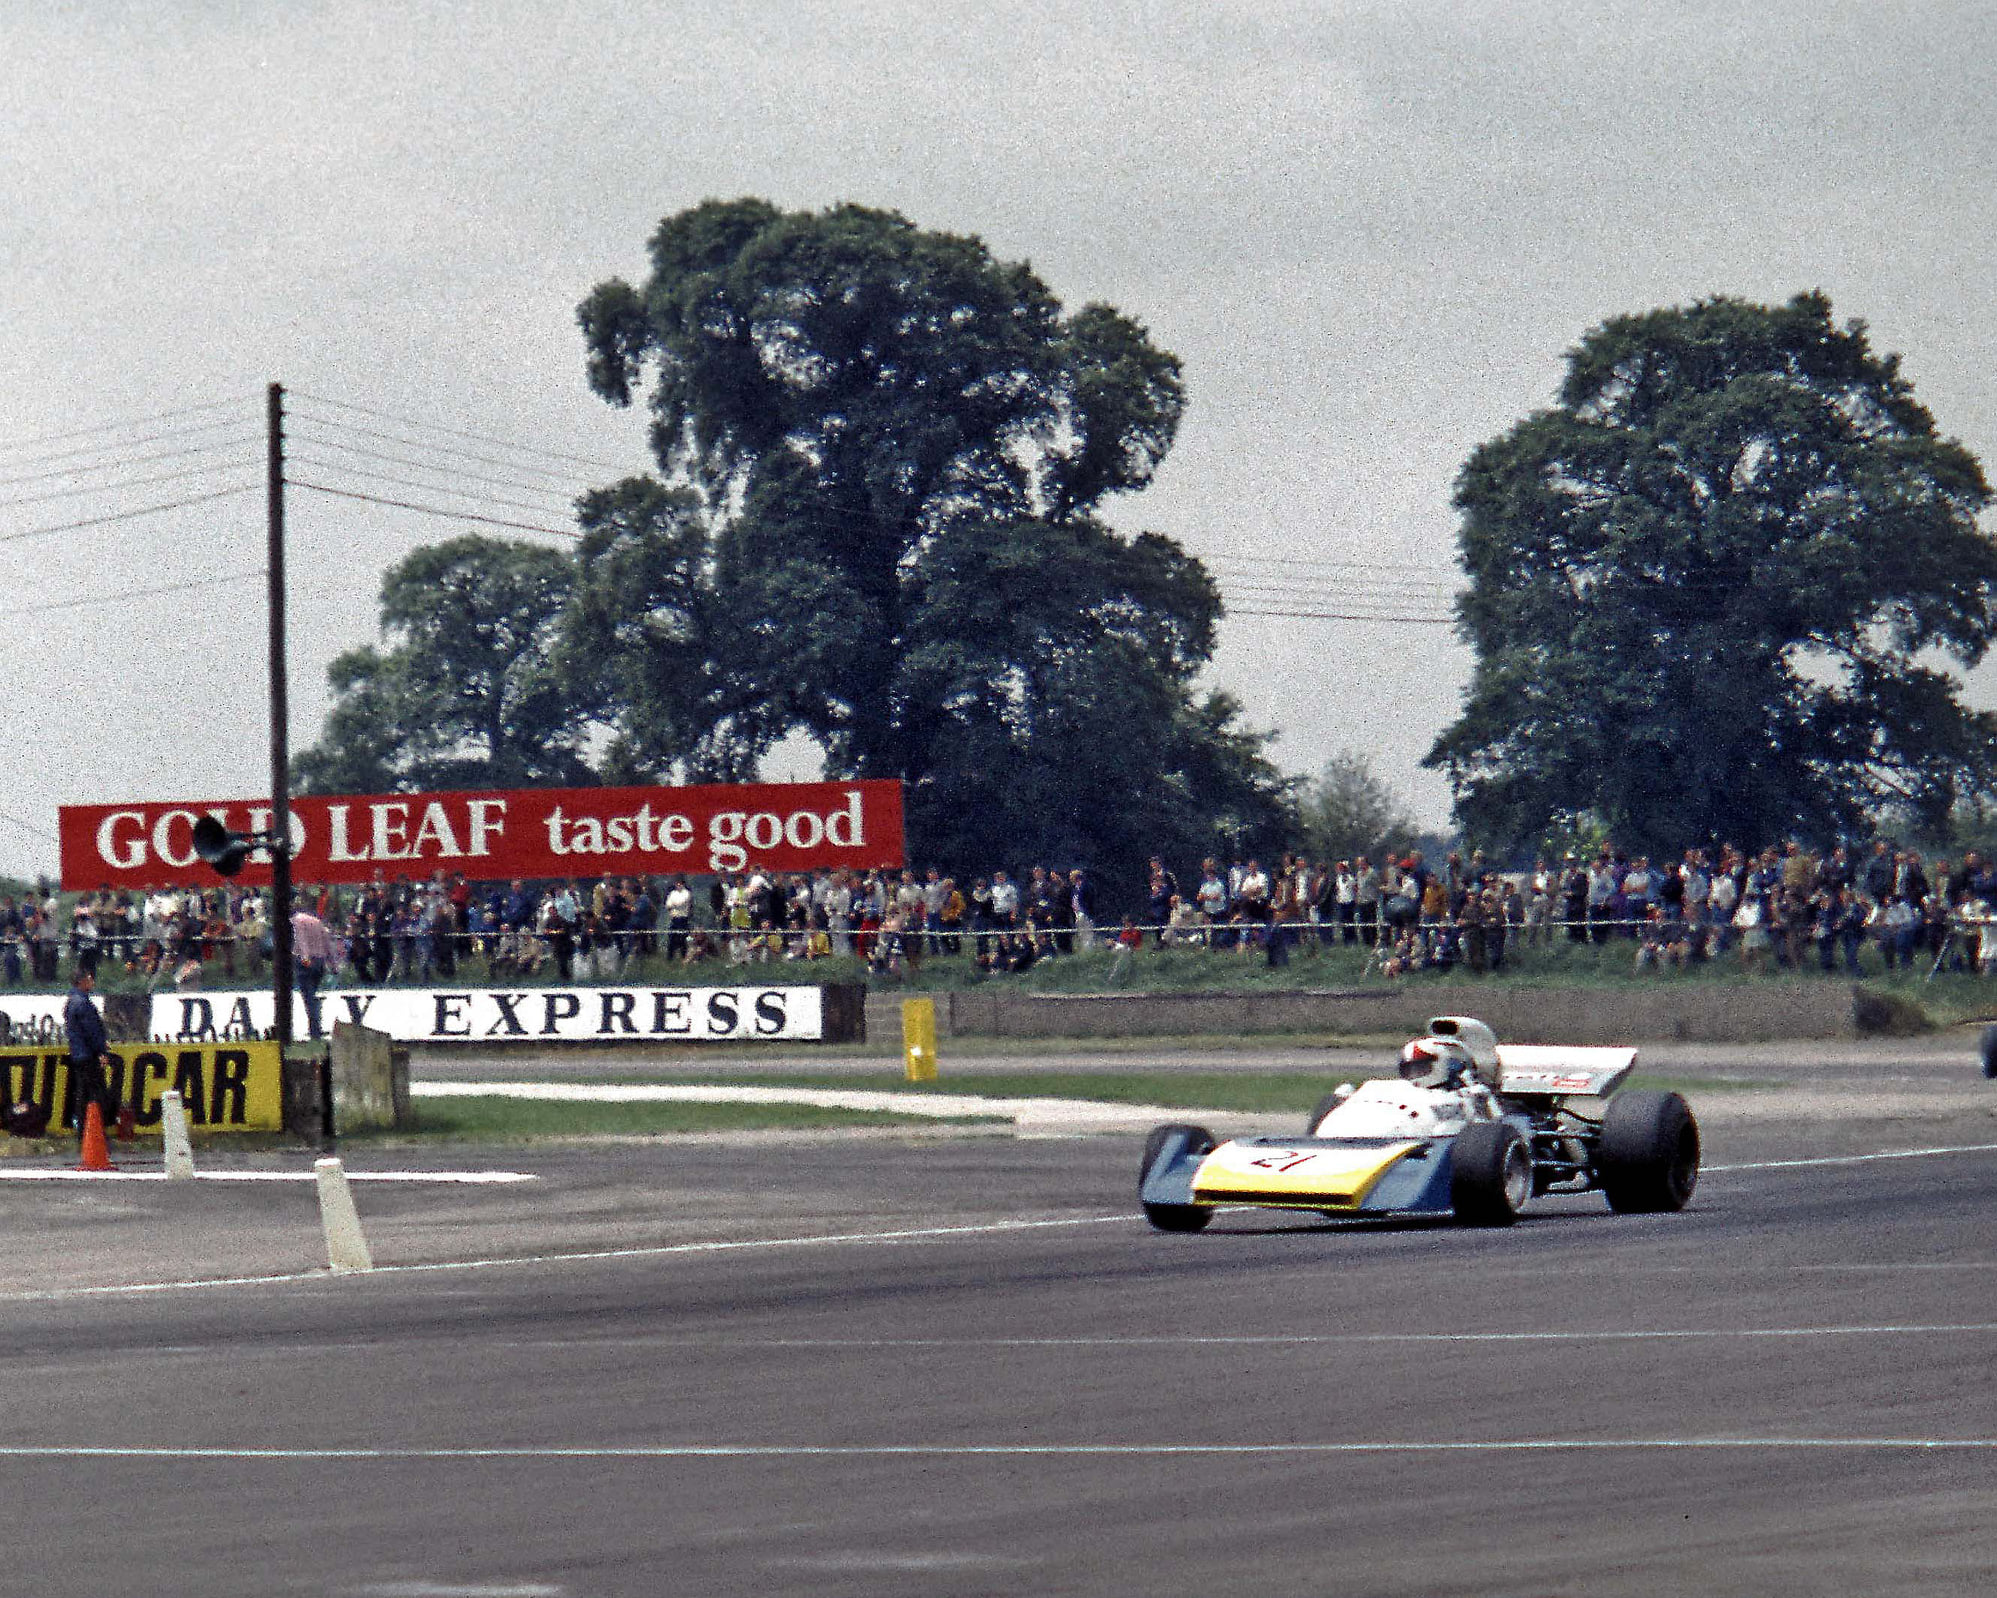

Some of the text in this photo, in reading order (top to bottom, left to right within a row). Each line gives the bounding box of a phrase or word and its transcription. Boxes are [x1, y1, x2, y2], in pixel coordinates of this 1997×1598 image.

[96, 791, 867, 872] GOD LEAF taste good
[178, 991, 788, 1036] DAY EXPRESS
